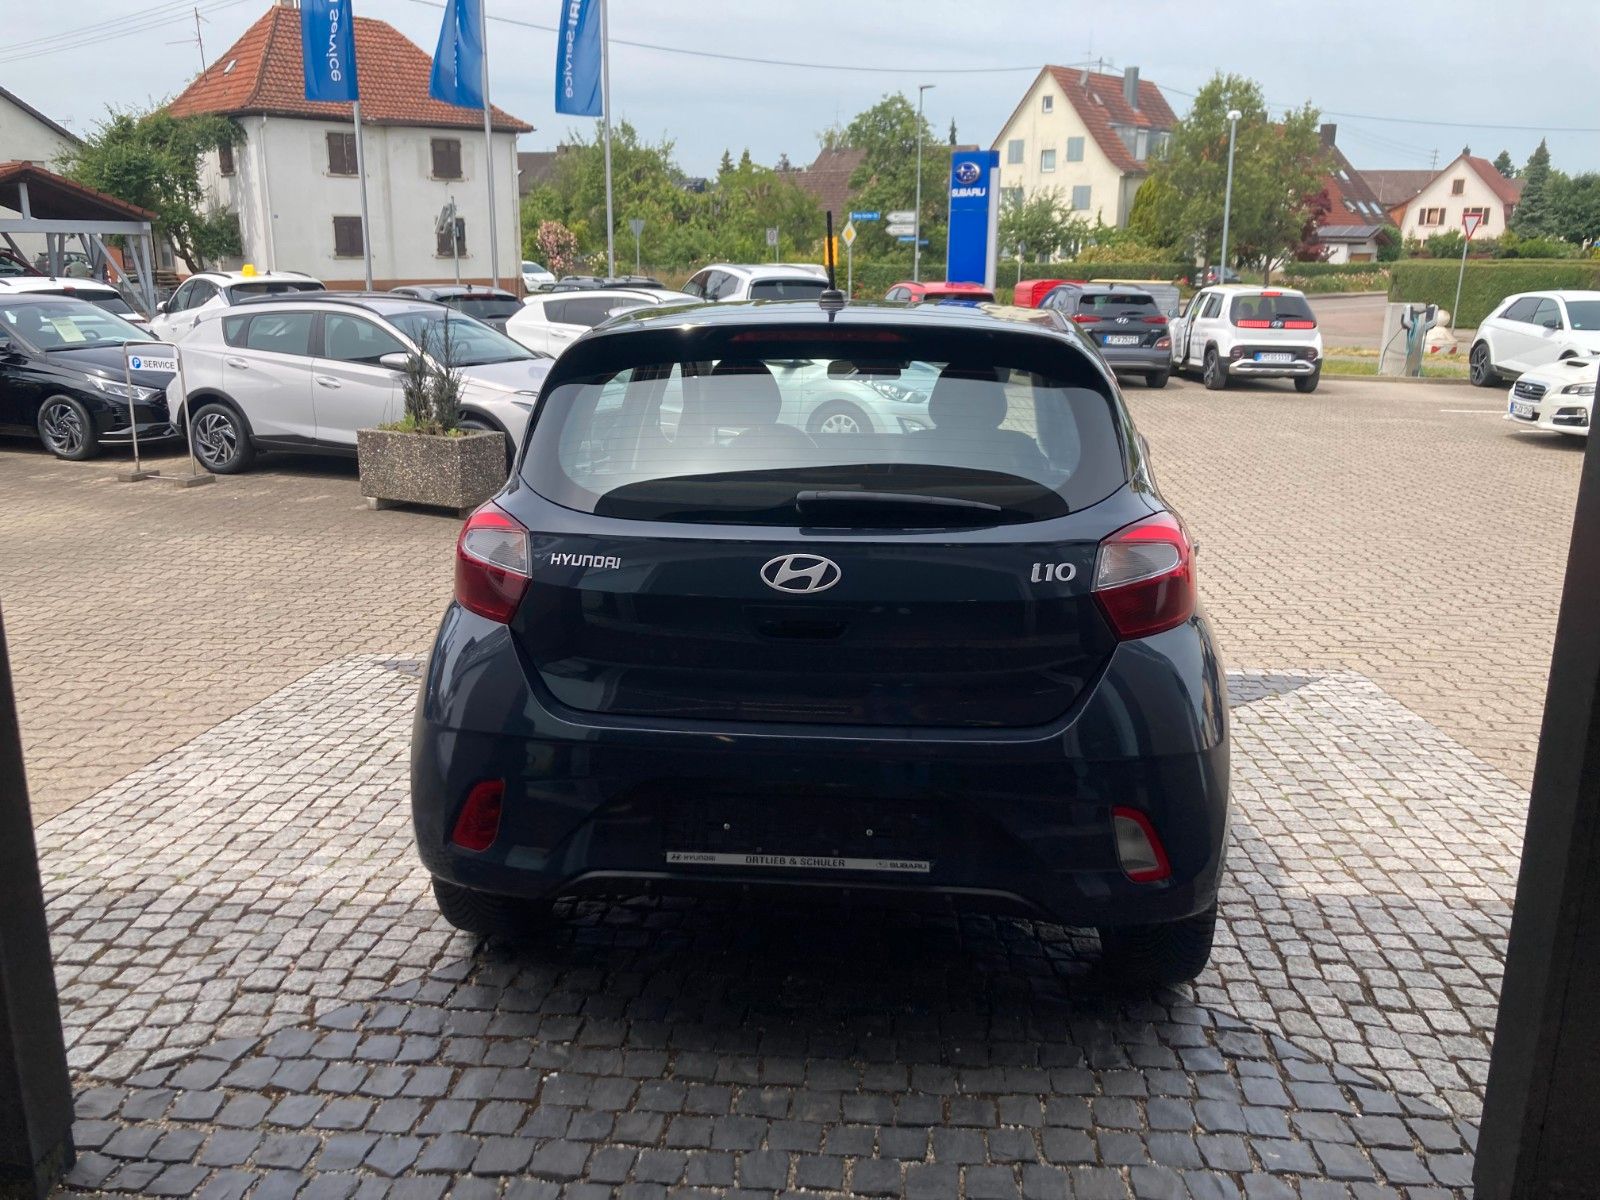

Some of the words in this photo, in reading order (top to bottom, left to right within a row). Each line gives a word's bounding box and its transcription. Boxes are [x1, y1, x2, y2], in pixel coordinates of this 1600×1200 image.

[951, 187, 986, 198] SUBARU
[144, 360, 175, 369] SERVICE
[550, 552, 621, 569] HYUNDAI
[683, 854, 717, 863] HYUNDAI
[745, 855, 786, 865] ORTLIEB
[789, 856, 797, 865] &
[889, 862, 928, 870] SUBARU
